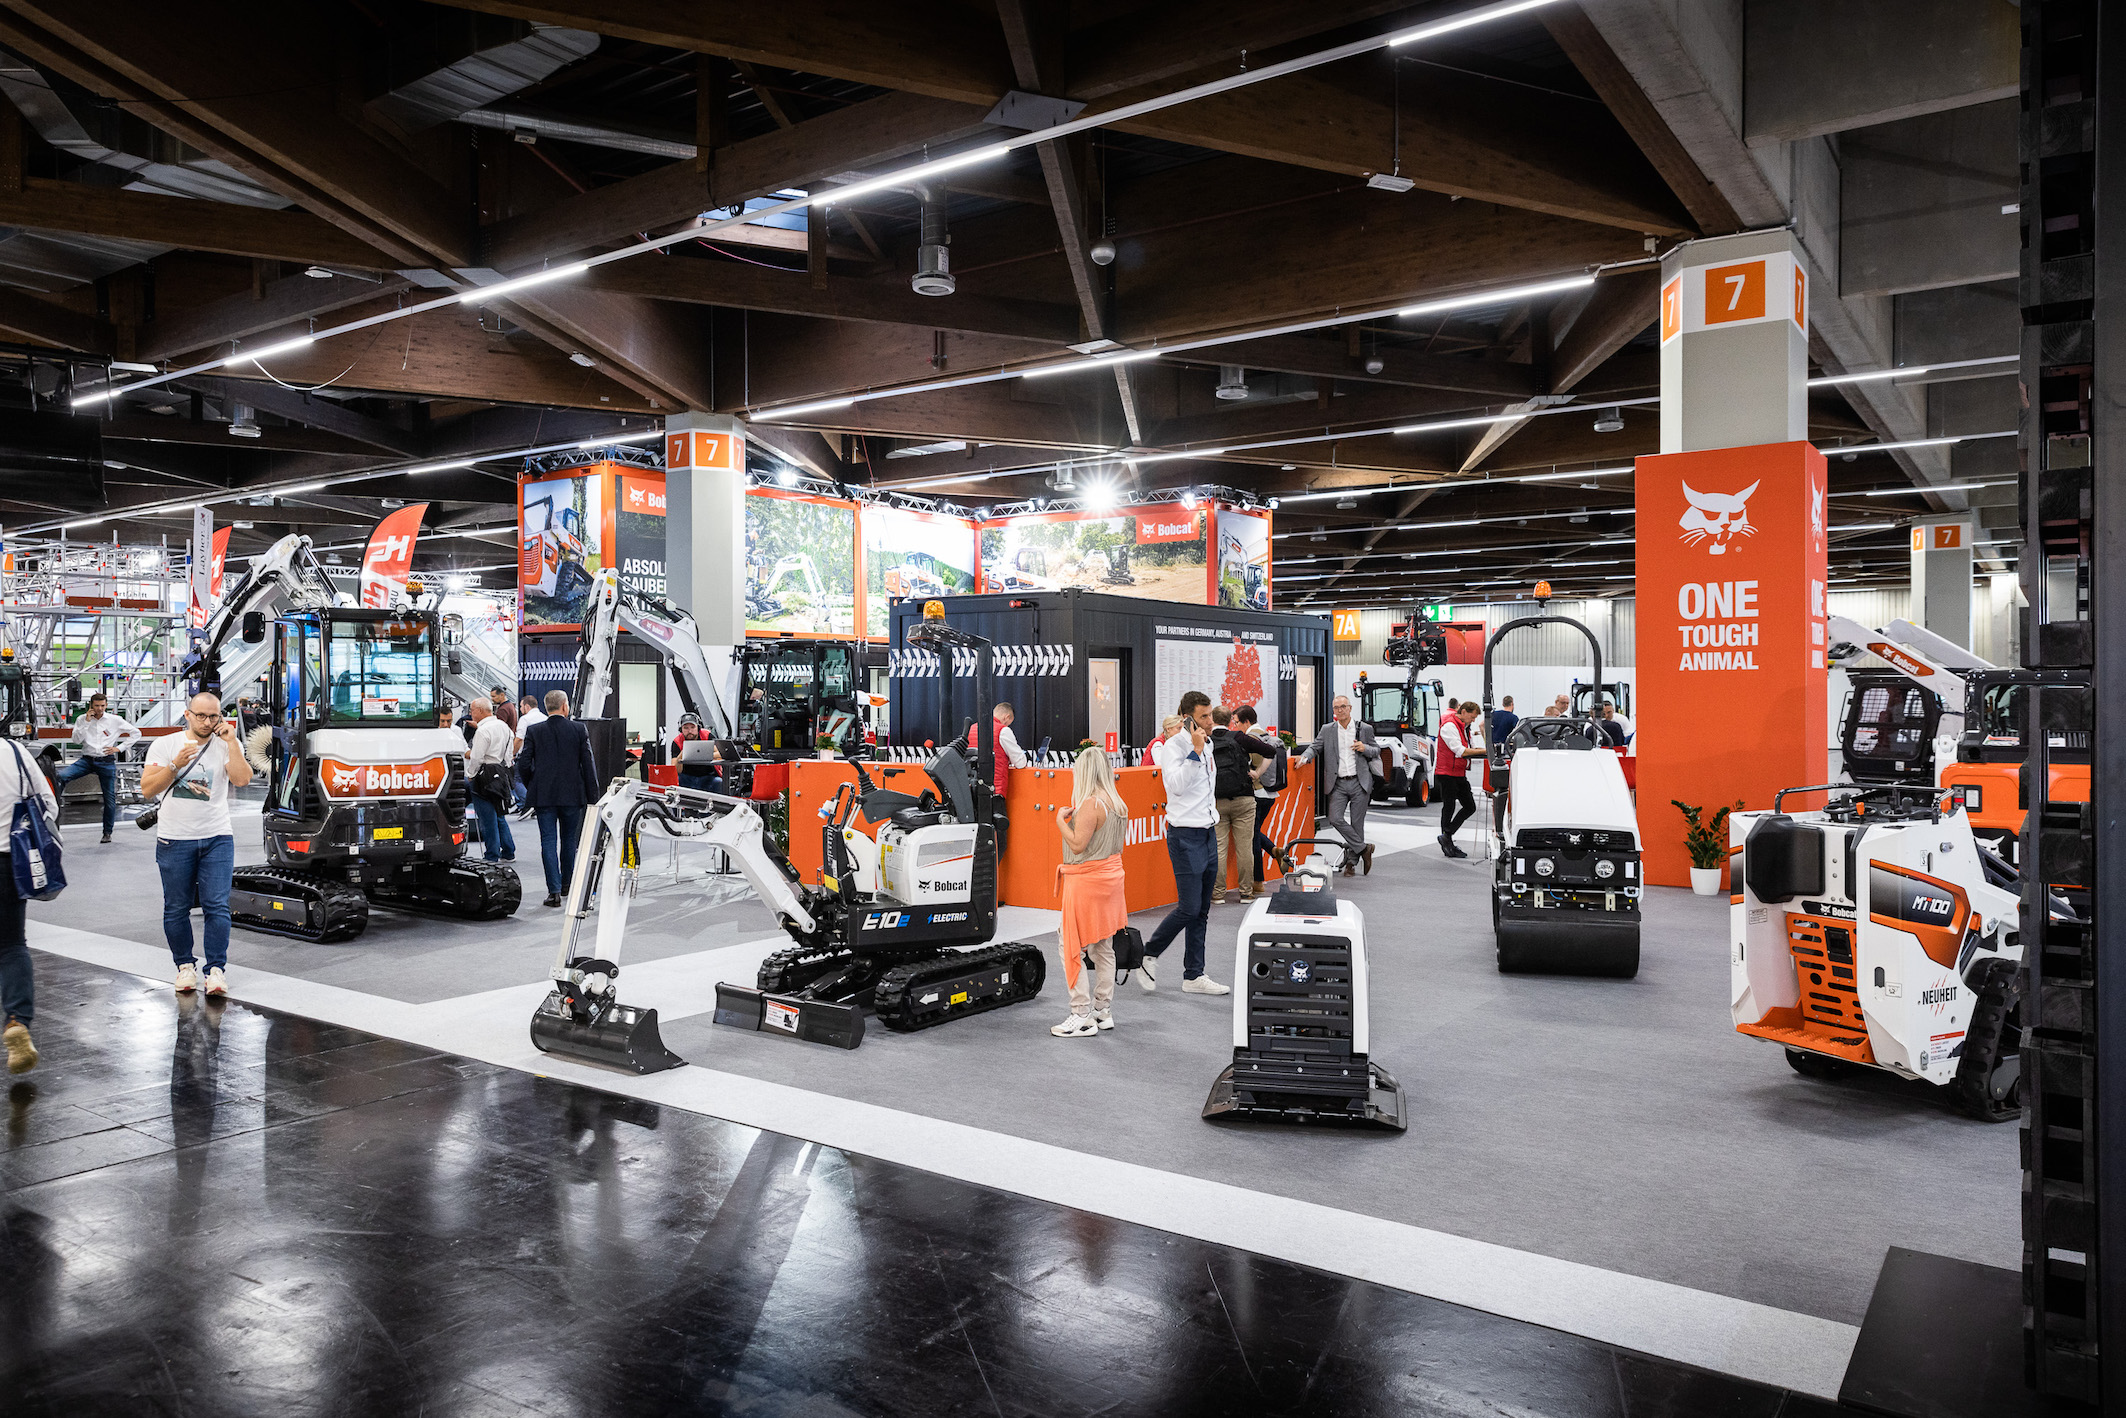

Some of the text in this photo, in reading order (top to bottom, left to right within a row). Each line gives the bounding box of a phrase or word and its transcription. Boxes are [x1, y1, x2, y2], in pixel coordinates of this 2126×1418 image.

[1724, 274, 1746, 311] 7
[1797, 279, 1802, 314] 7
[1667, 291, 1675, 328] 7
[674, 440, 683, 462] 7
[706, 439, 719, 461] 7
[736, 444, 742, 465] 7
[1157, 521, 1192, 537] Bobcat
[1915, 532, 1921, 546] 7
[1943, 530, 1953, 544] 7
[1678, 580, 1759, 620] ONE
[1155, 625, 1167, 635] YOUR
[1168, 626, 1189, 636] PARTNERS
[1190, 627, 1195, 636] IN
[1195, 628, 1215, 638] GERMANY,
[1215, 629, 1232, 639] AUSTRIA
[1241, 631, 1249, 640] AND
[1336, 614, 1357, 636] 7A
[1678, 623, 1759, 649] TOUGH
[1678, 651, 1759, 672] ANIMAL
[1892, 654, 1919, 675] Bobcat
[366, 770, 430, 790] Bobcat
[934, 880, 967, 892] Bobcat
[932, 912, 968, 923] ELECTRIC
[1922, 986, 1958, 1005] NEUHEIT
